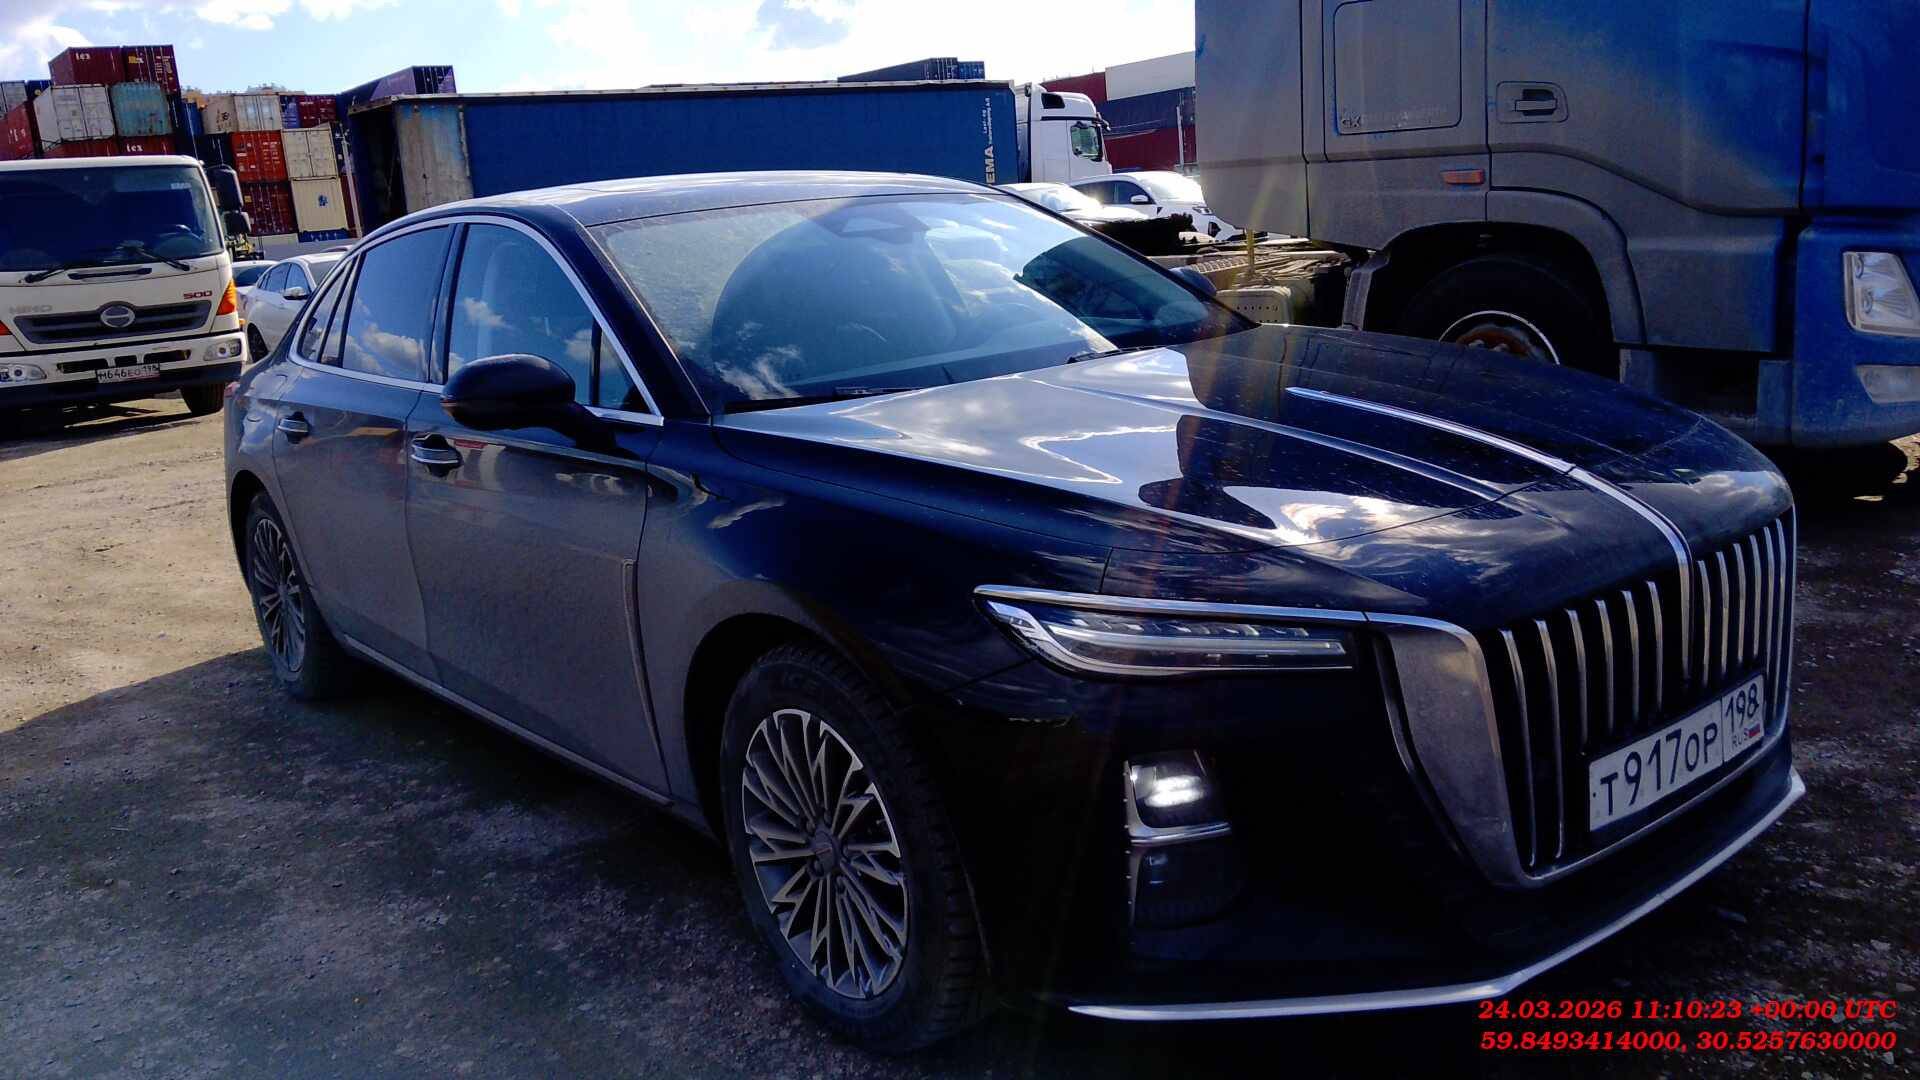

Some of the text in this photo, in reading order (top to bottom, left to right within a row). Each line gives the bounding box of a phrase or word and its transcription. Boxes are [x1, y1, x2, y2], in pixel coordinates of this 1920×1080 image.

[984, 146, 995, 185] EMA
[183, 290, 213, 299] 500
[1725, 683, 1759, 734] 198
